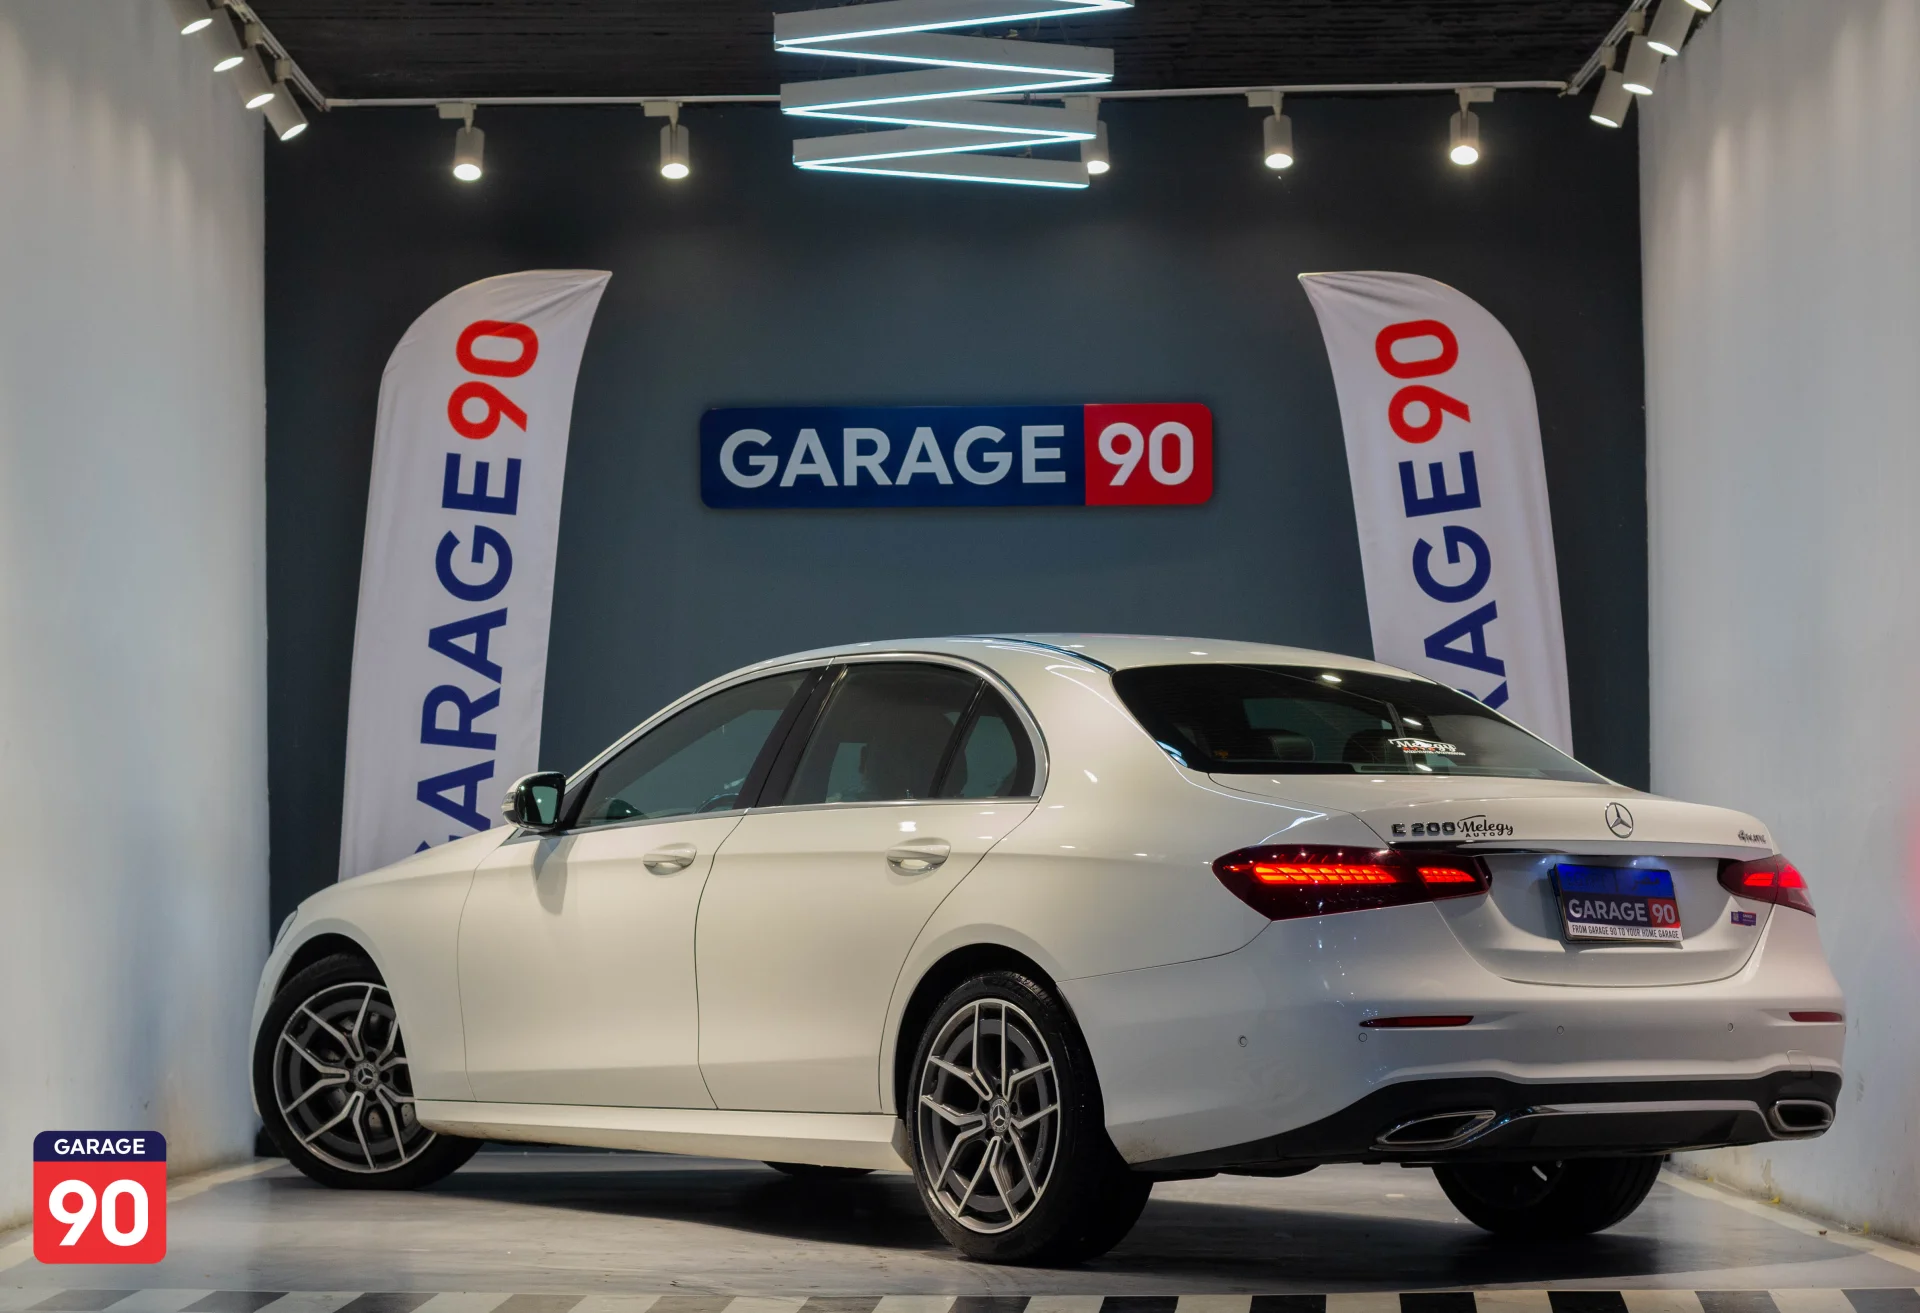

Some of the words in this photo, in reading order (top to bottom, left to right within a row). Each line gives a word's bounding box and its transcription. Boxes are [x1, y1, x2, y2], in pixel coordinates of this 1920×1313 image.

[719, 425, 1066, 488] GARAGE
[1098, 421, 1194, 487] 90
[1391, 823, 1406, 837] E
[1411, 822, 1455, 836] 200
[1460, 819, 1514, 836] Melegy
[1568, 898, 1648, 922] GARAGE
[1652, 903, 1675, 924] 90
[1572, 924, 1587, 933] FROM
[1588, 925, 1609, 935] GARAGE
[1610, 927, 1617, 935] 90
[1617, 927, 1626, 936] TO
[1626, 928, 1640, 936] YOUR
[1641, 929, 1657, 937] HOME
[1658, 930, 1680, 939] GARAGE
